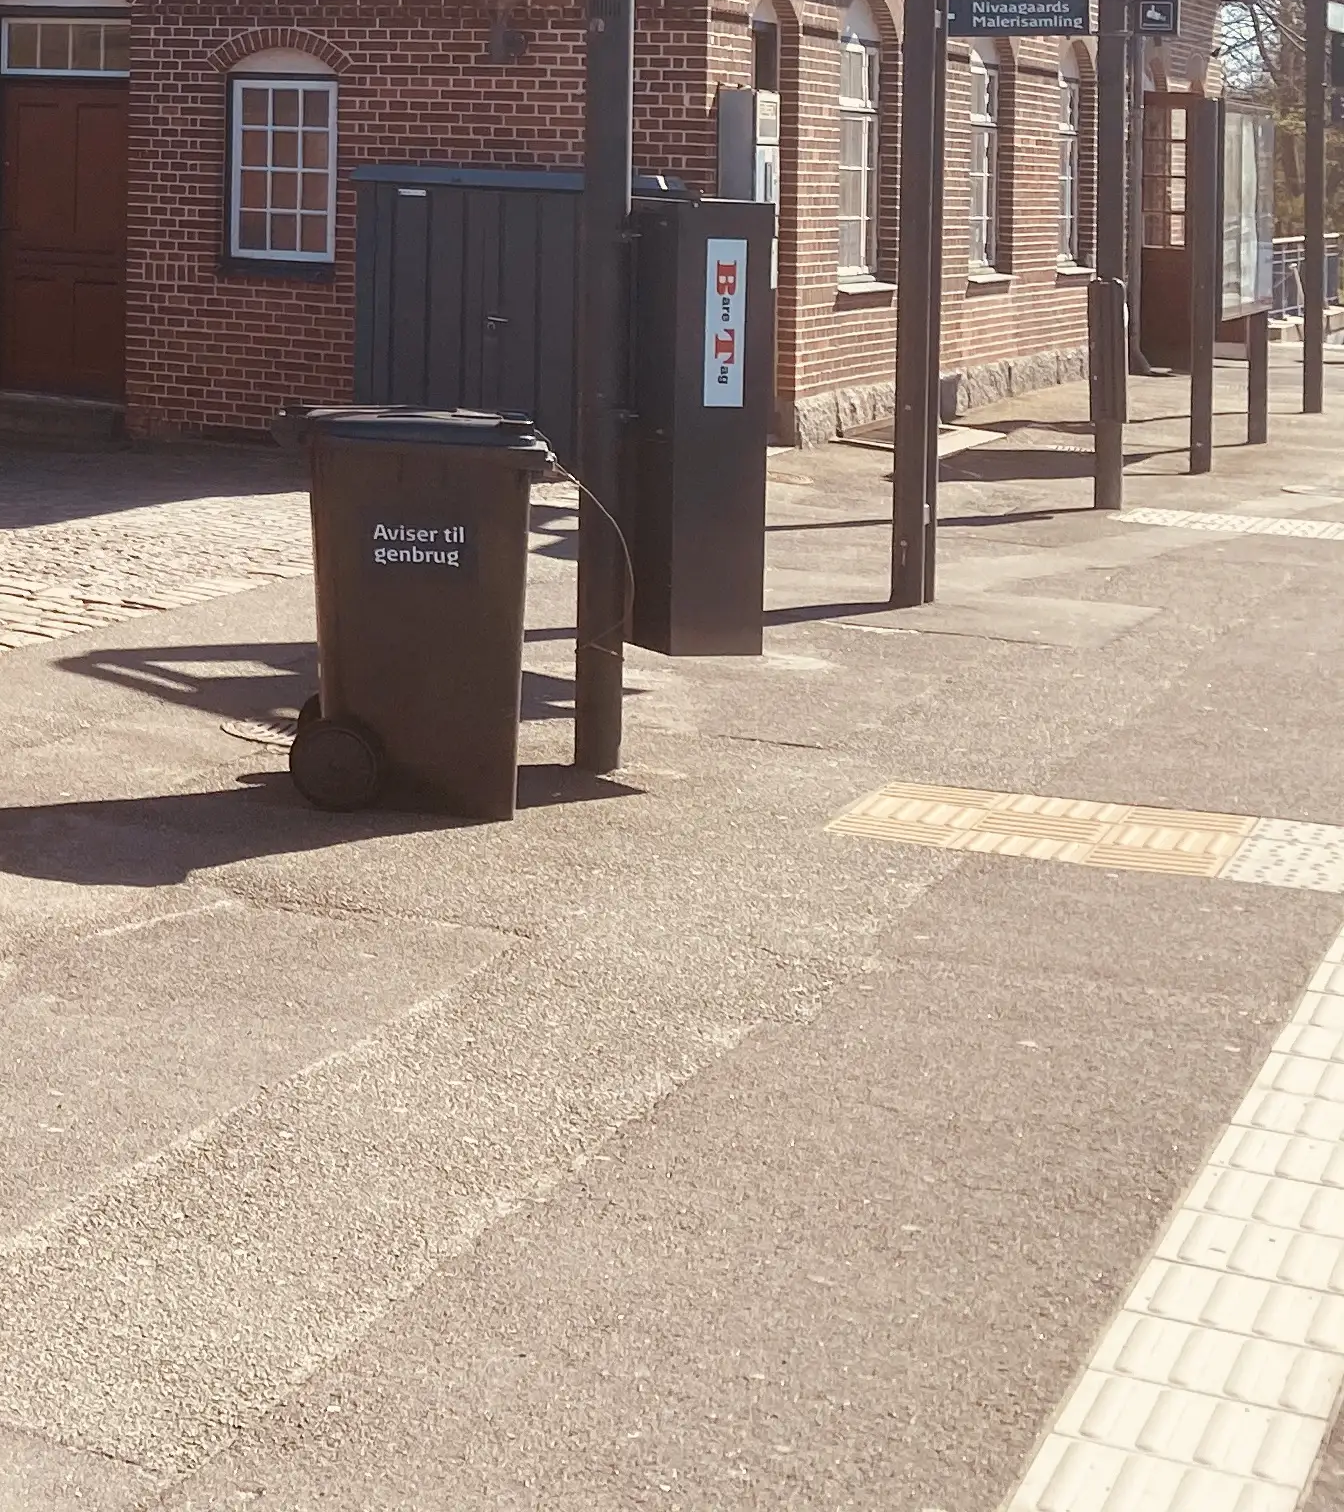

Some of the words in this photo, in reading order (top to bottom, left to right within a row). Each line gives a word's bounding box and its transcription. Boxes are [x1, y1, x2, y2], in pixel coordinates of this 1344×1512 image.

[972, 1, 1070, 15] Nivaagaards
[972, 15, 1084, 29] Malerisamling
[716, 259, 737, 322] Bare
[714, 328, 736, 385] Tag
[373, 523, 439, 543] Aviser
[443, 526, 465, 544] til
[374, 545, 460, 568] genbrug
